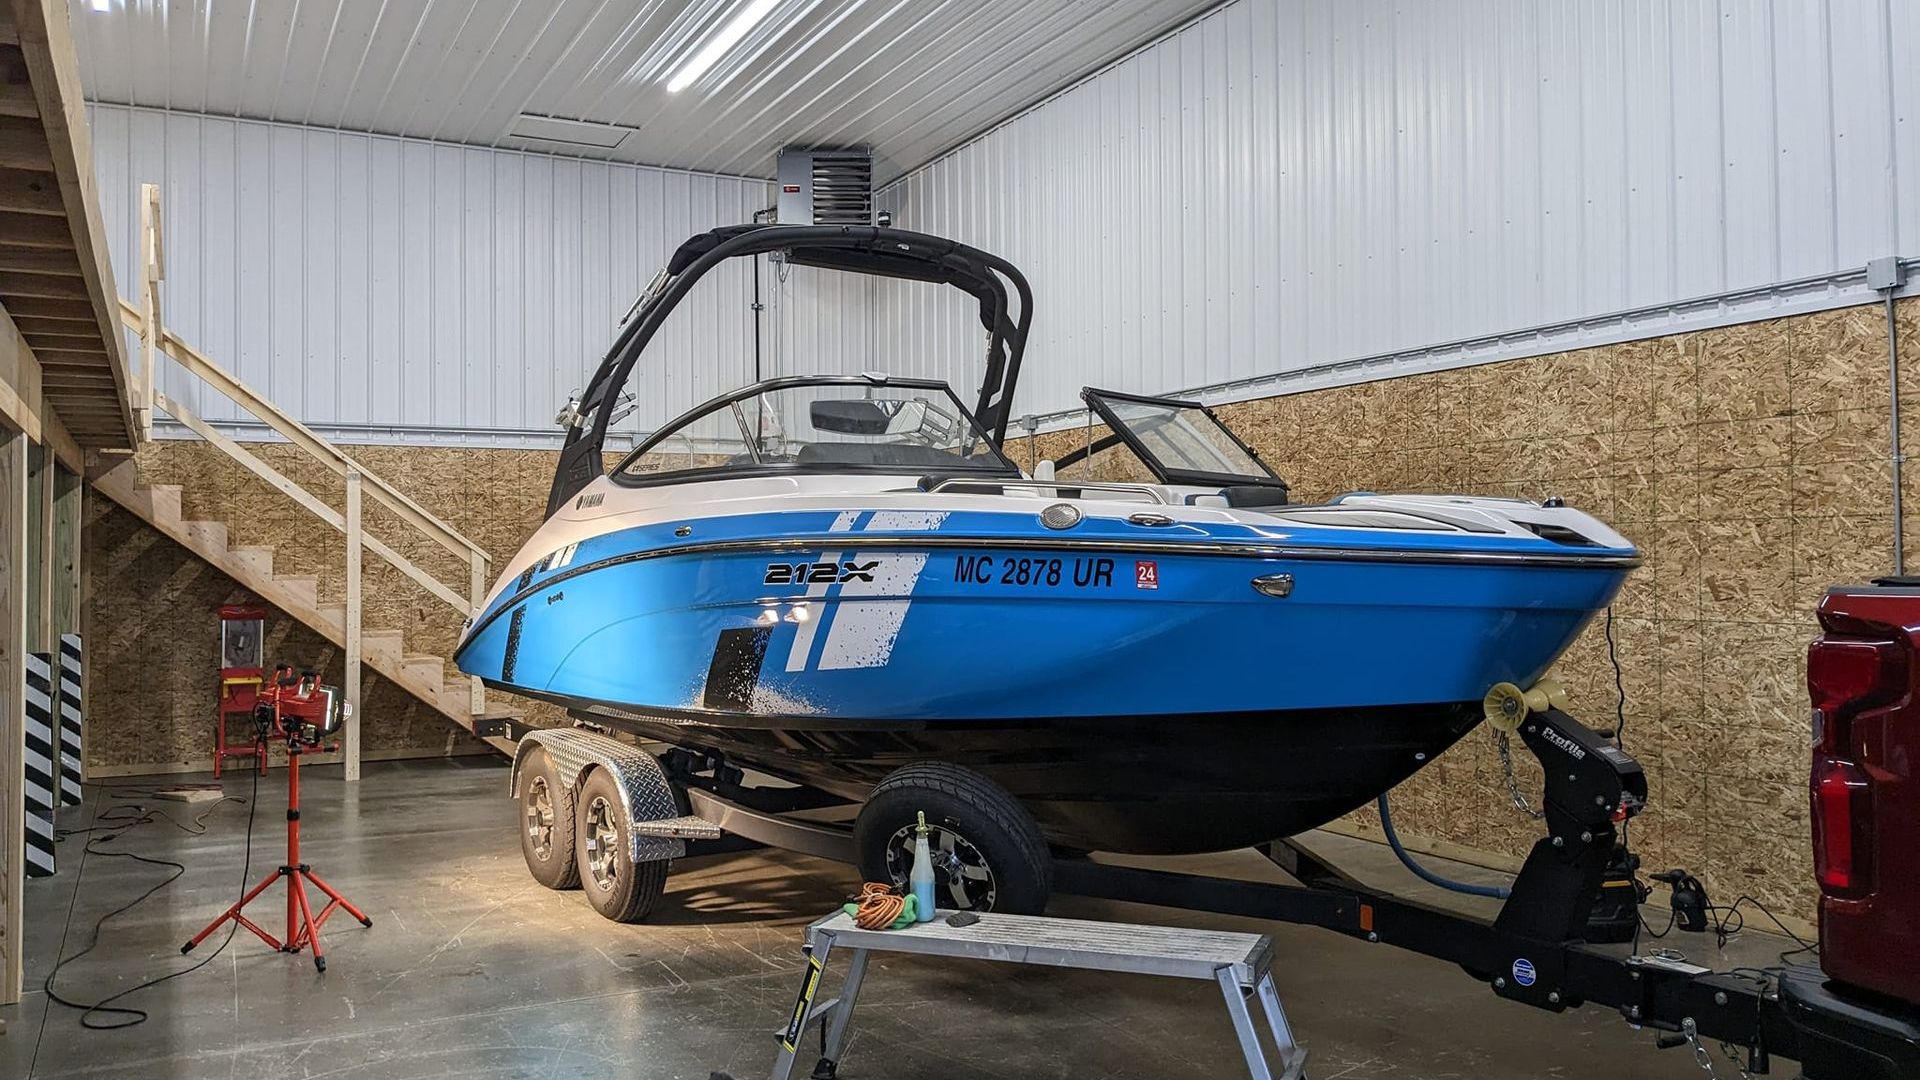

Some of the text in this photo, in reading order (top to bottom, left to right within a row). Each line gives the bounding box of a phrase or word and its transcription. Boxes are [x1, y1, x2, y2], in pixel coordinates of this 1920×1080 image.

[763, 558, 880, 584] 212X
[954, 555, 1115, 587] MC 2878 UR
[1138, 566, 1155, 581] 24
[1542, 726, 1586, 759] Profile
